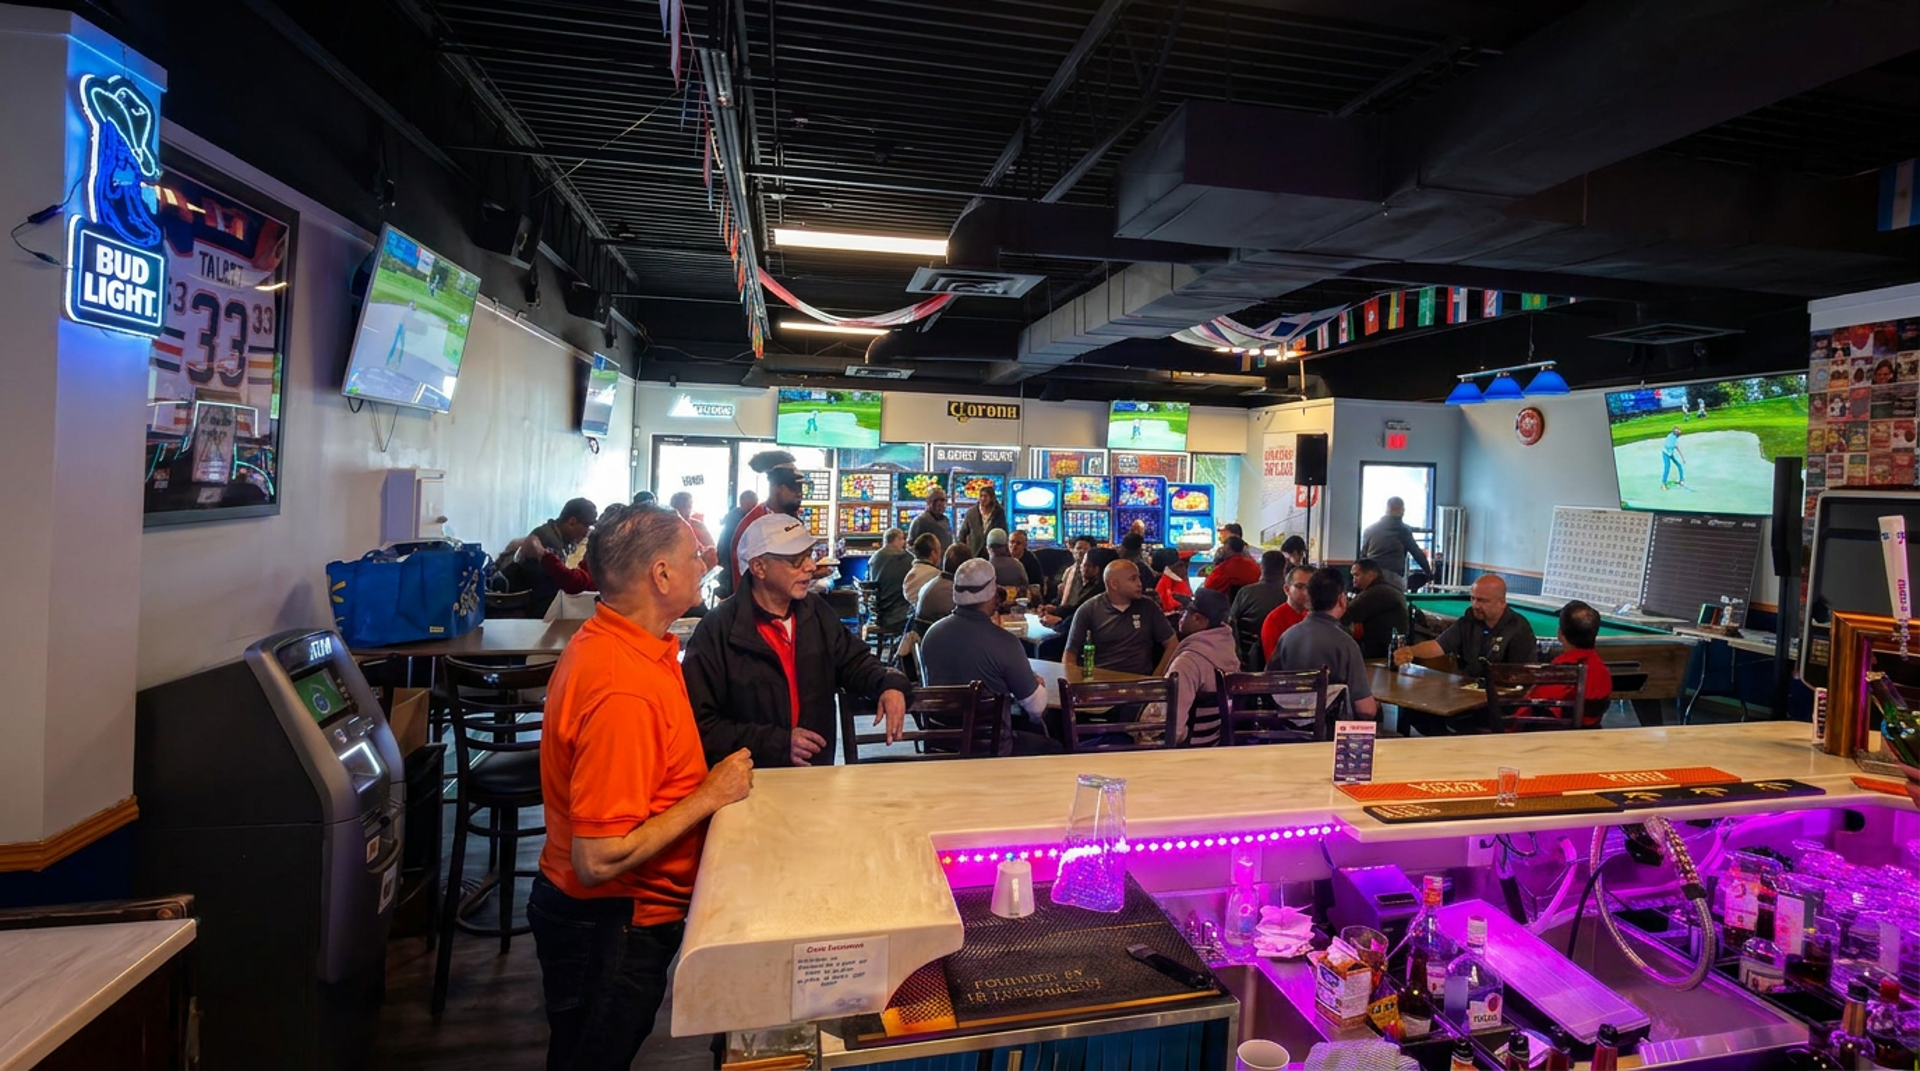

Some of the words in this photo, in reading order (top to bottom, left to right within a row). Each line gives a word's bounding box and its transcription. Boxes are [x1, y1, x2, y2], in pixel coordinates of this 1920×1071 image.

[96, 243, 149, 285] BUD
[187, 289, 249, 388] 33
[252, 303, 274, 335] 33
